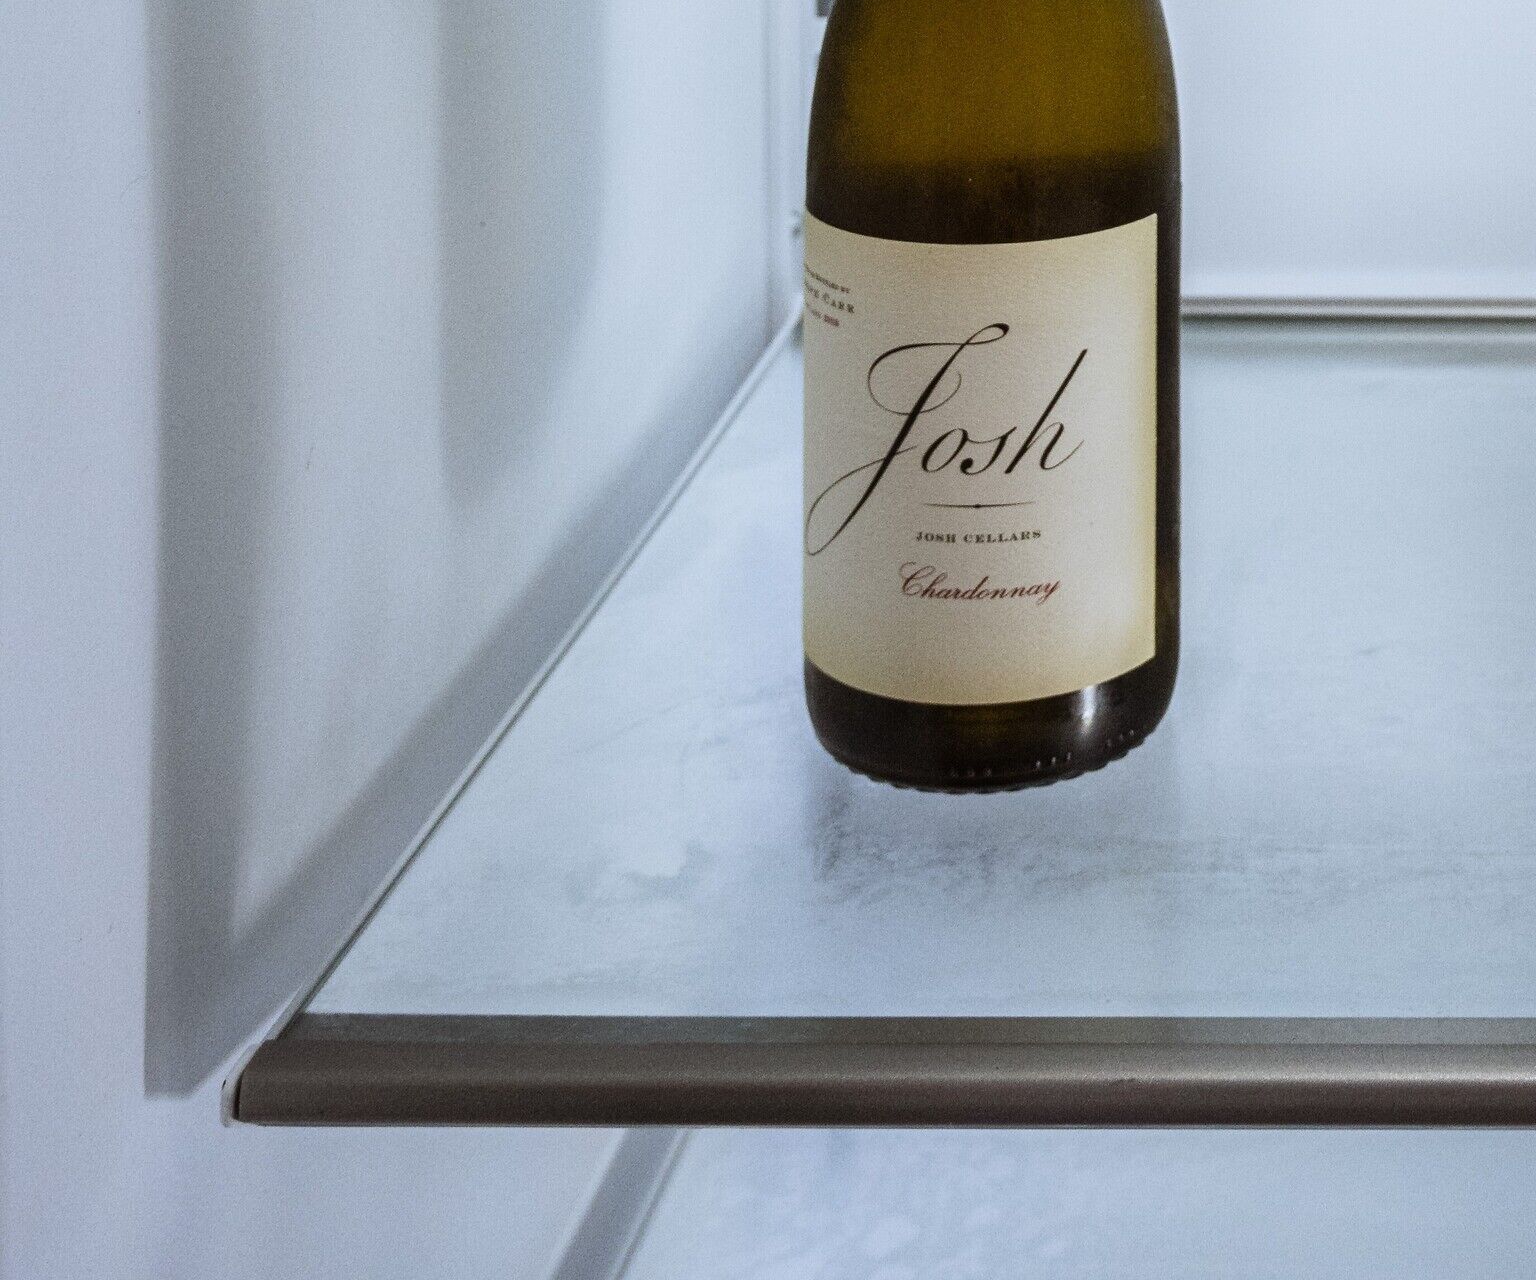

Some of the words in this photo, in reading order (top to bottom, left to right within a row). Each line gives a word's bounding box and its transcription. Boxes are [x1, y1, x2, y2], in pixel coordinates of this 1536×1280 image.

[805, 322, 1088, 556] Josh
[916, 531, 957, 544] JOSH
[963, 529, 1042, 544] CELLARS
[900, 561, 1063, 604] Chardonnay
